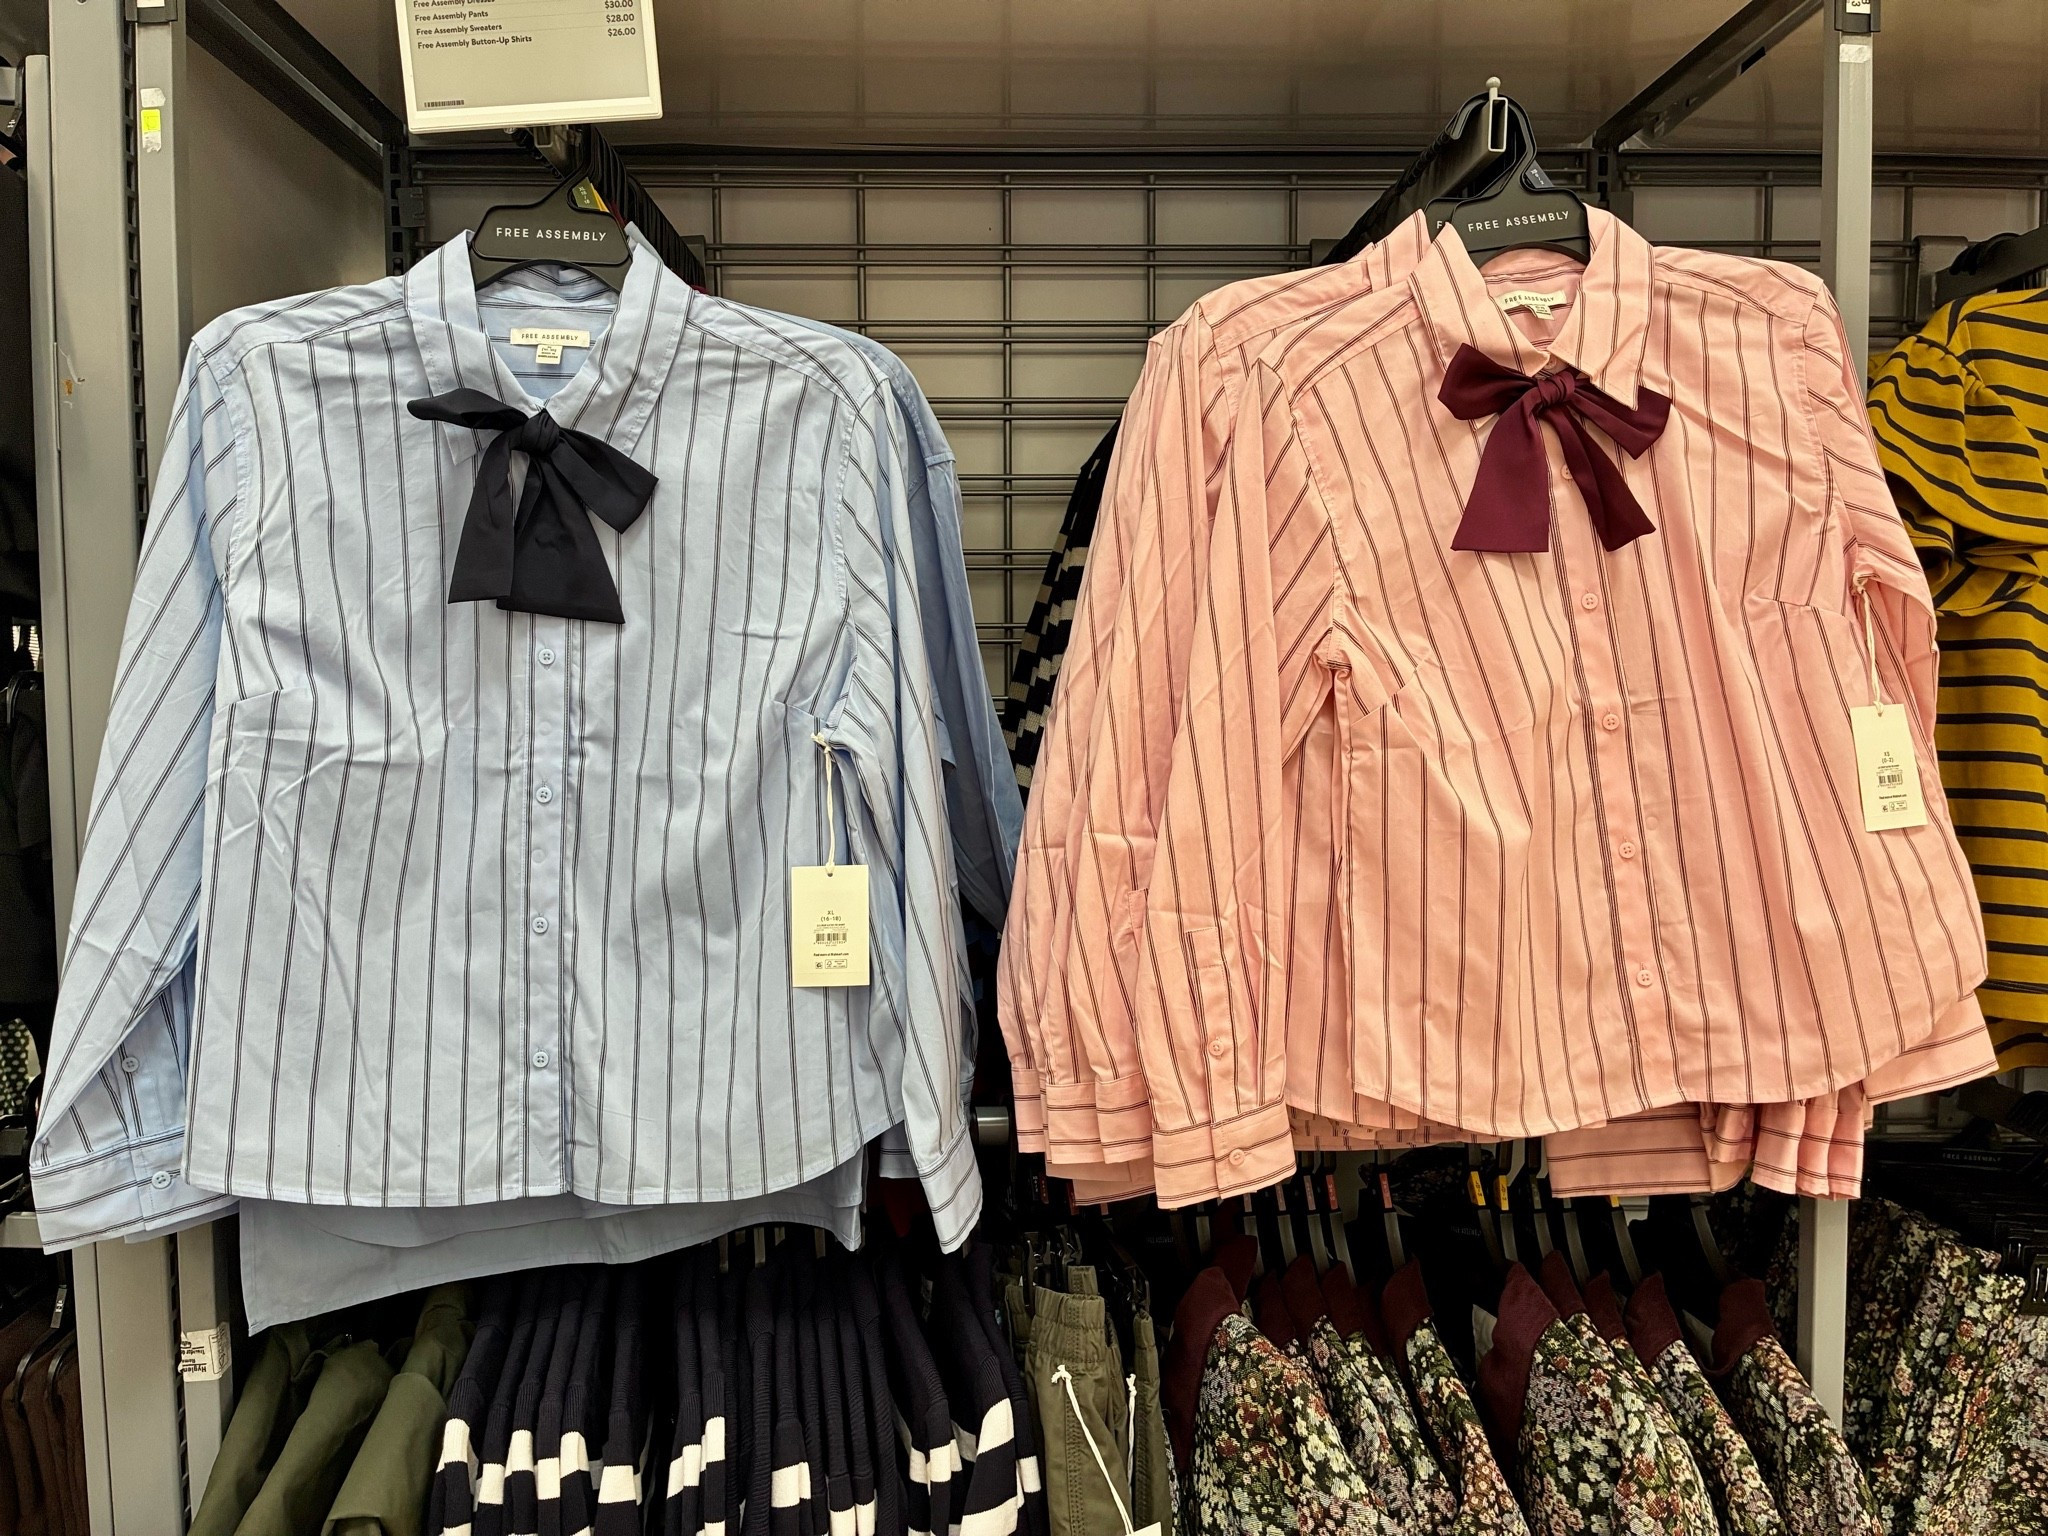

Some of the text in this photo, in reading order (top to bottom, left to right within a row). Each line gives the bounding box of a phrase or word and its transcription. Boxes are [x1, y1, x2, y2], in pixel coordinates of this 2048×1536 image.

[413, 0, 430, 8] Free
[432, 11, 467, 20] Assembly
[468, 10, 489, 18] Pants
[604, 0, 633, 9] $30.00
[416, 13, 635, 36] Free Assembly Sweaters $28.00
[417, 27, 636, 49] Free Assembly Button-Up Shirts $26.00
[1467, 210, 1570, 232] FREE ASSEMBLY
[496, 227, 607, 242] FREE ASSEMBLY
[1504, 294, 1554, 304] FREE ASSEMBLY
